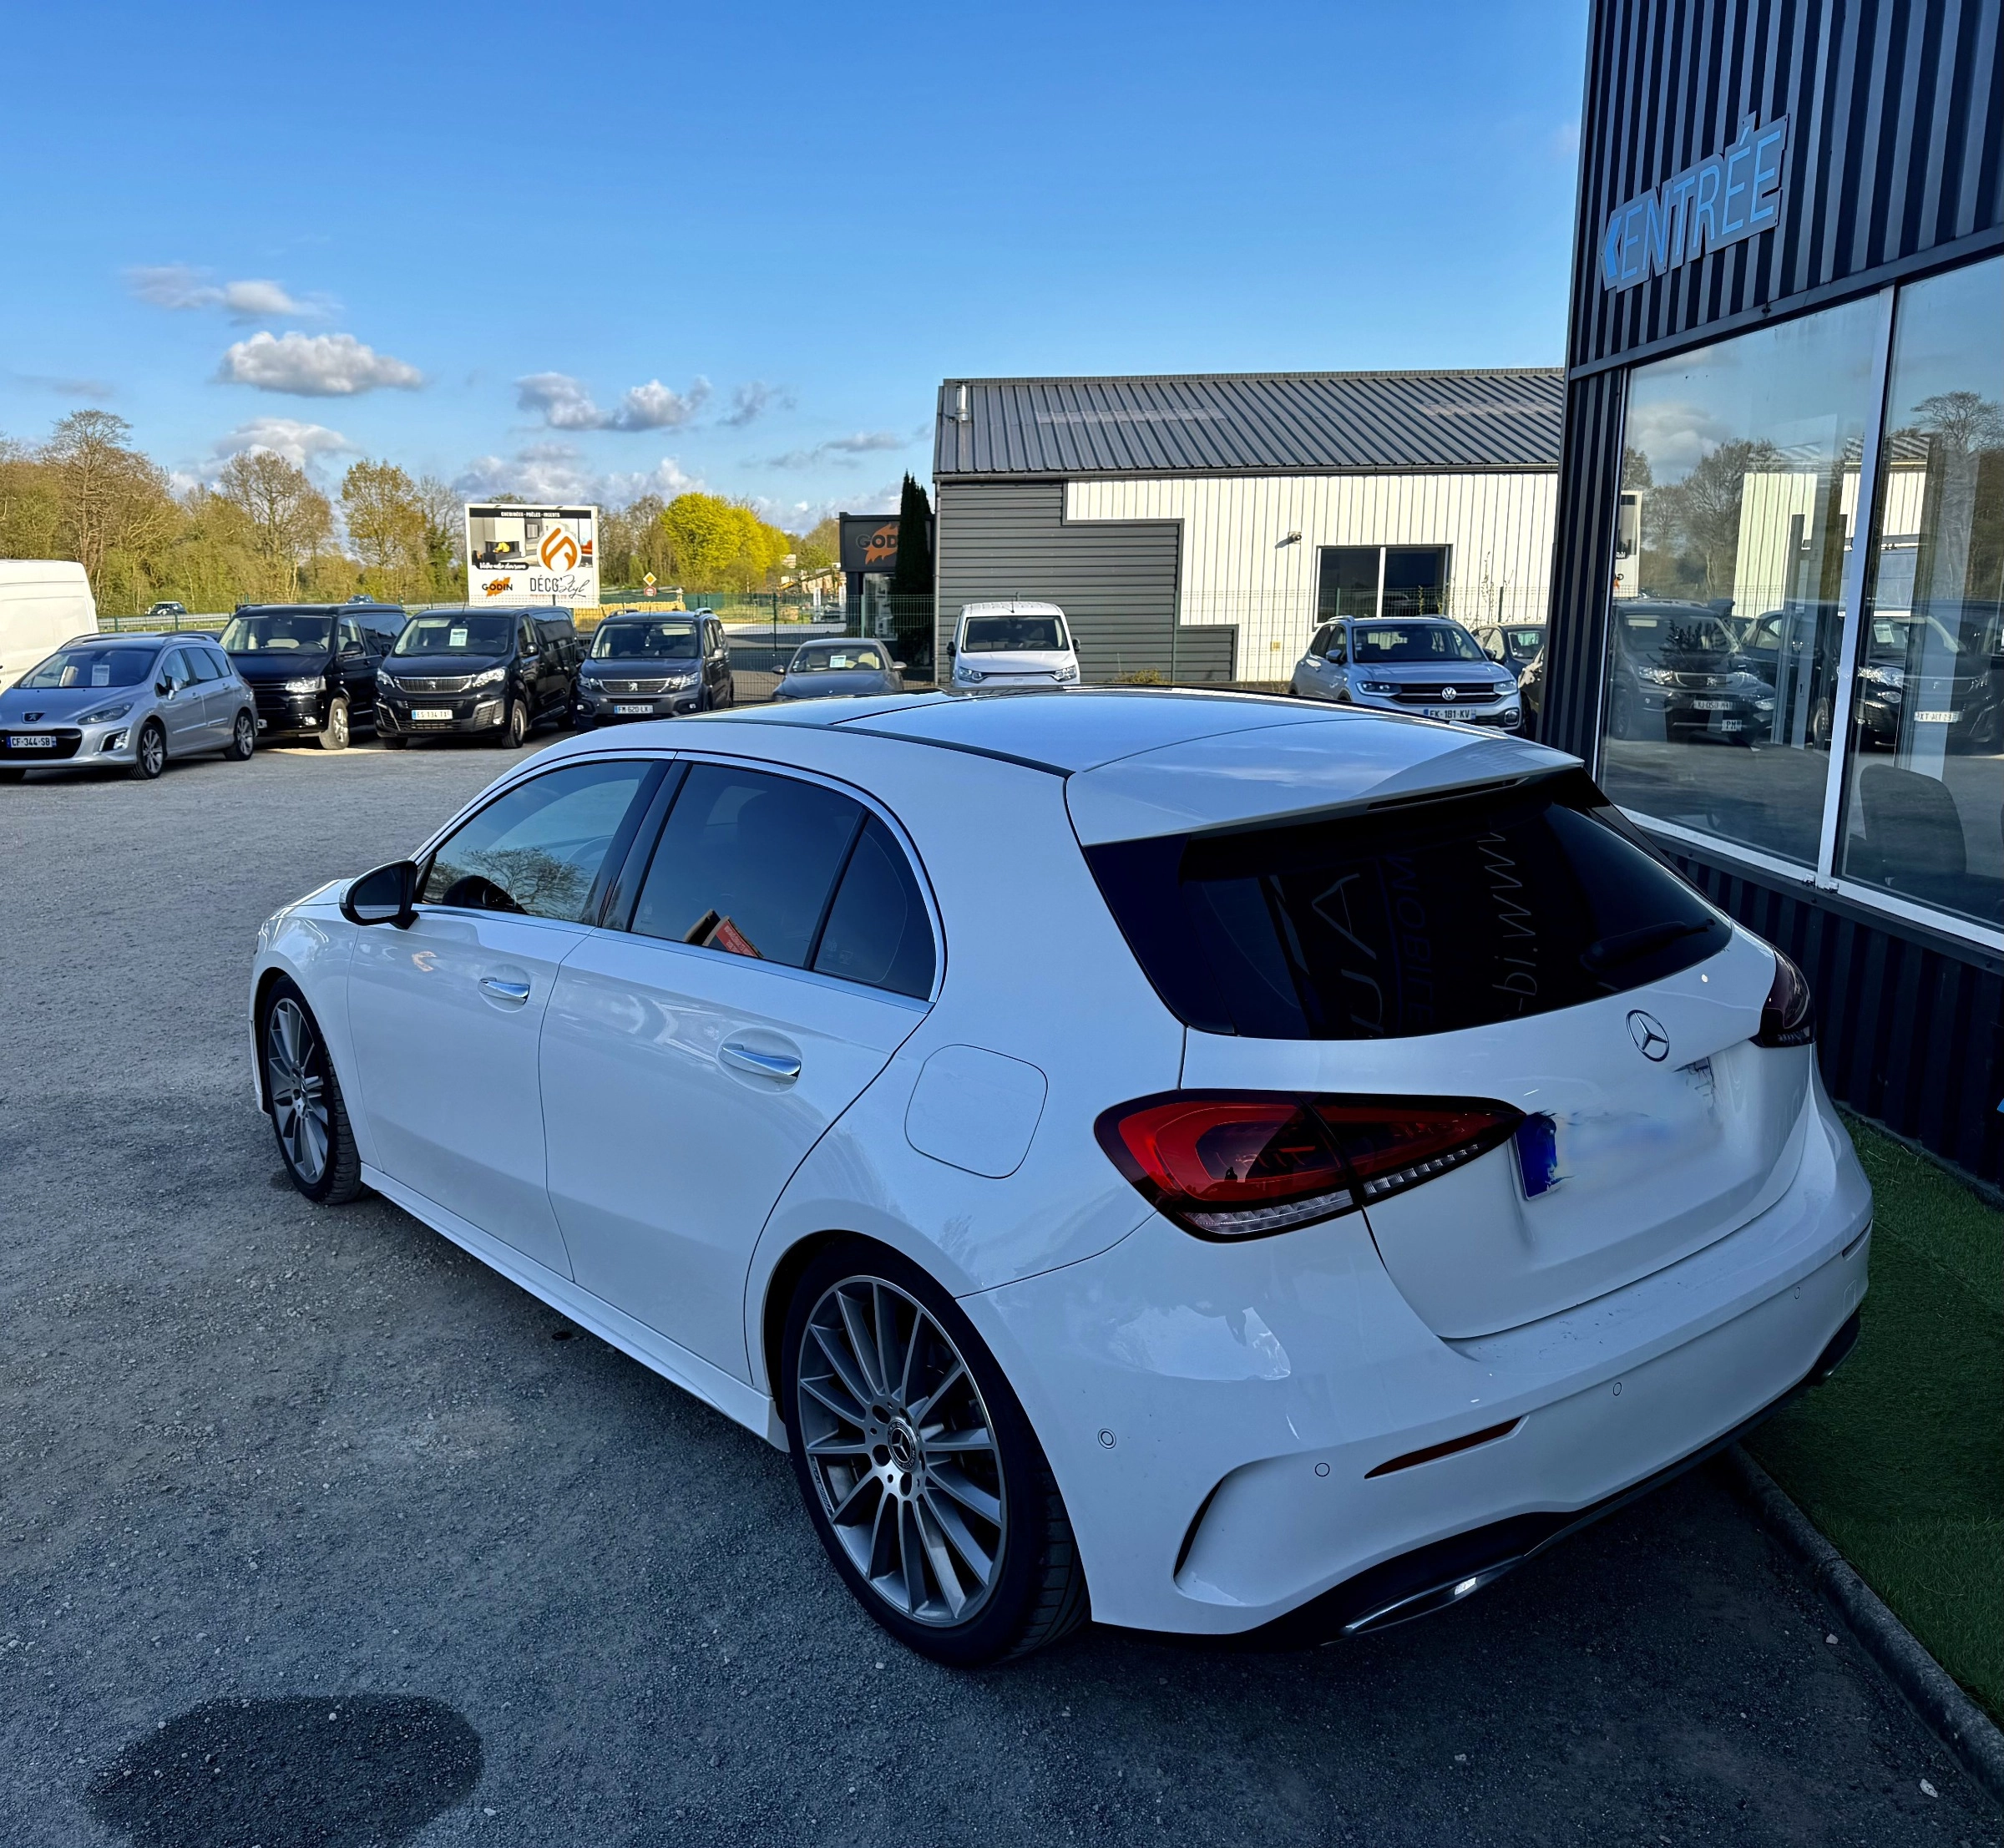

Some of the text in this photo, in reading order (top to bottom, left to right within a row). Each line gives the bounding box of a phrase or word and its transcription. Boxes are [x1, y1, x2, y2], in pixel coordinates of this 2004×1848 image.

[1620, 126, 1781, 281] ENTRÉE
[856, 534, 898, 549] GOD
[481, 583, 513, 591] GODIN
